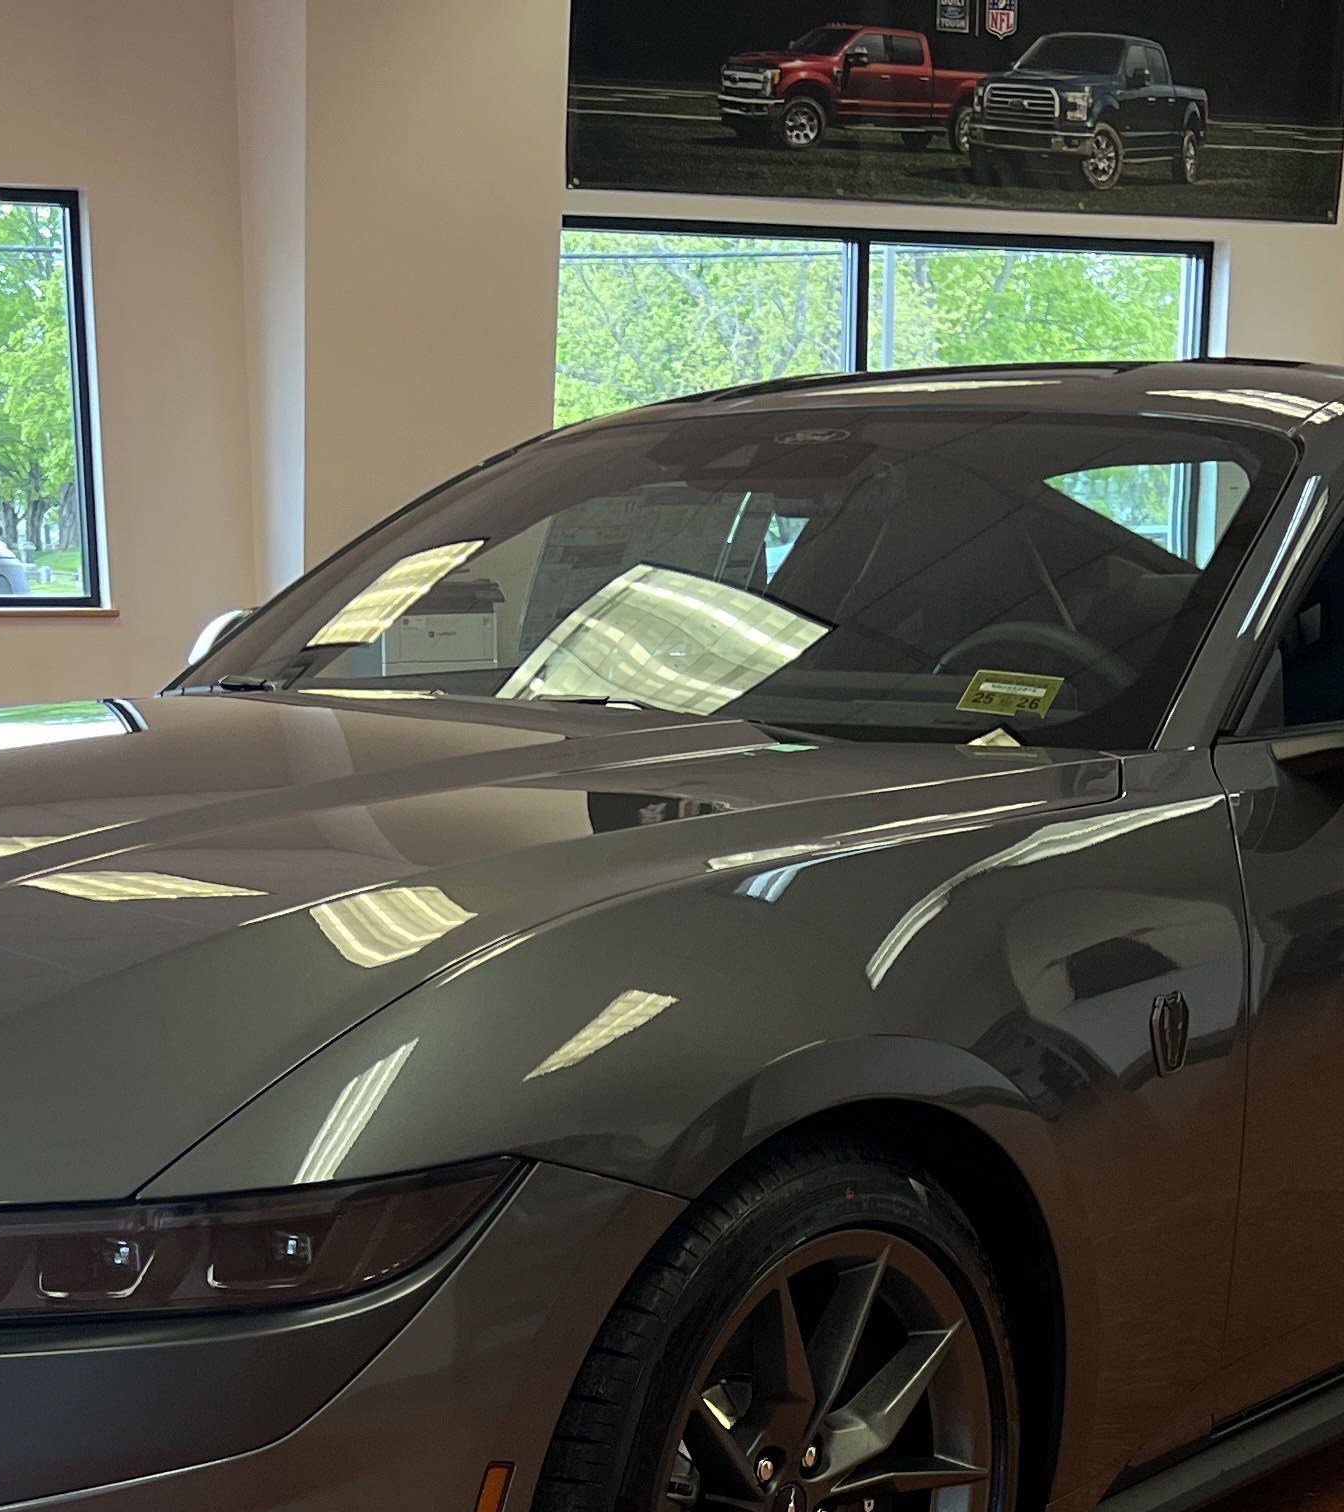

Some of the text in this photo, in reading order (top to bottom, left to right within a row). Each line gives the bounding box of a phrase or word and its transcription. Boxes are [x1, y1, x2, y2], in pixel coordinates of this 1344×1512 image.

[991, 12, 1013, 31] NFL
[972, 693, 995, 704] 25
[1016, 698, 1040, 710] 26
